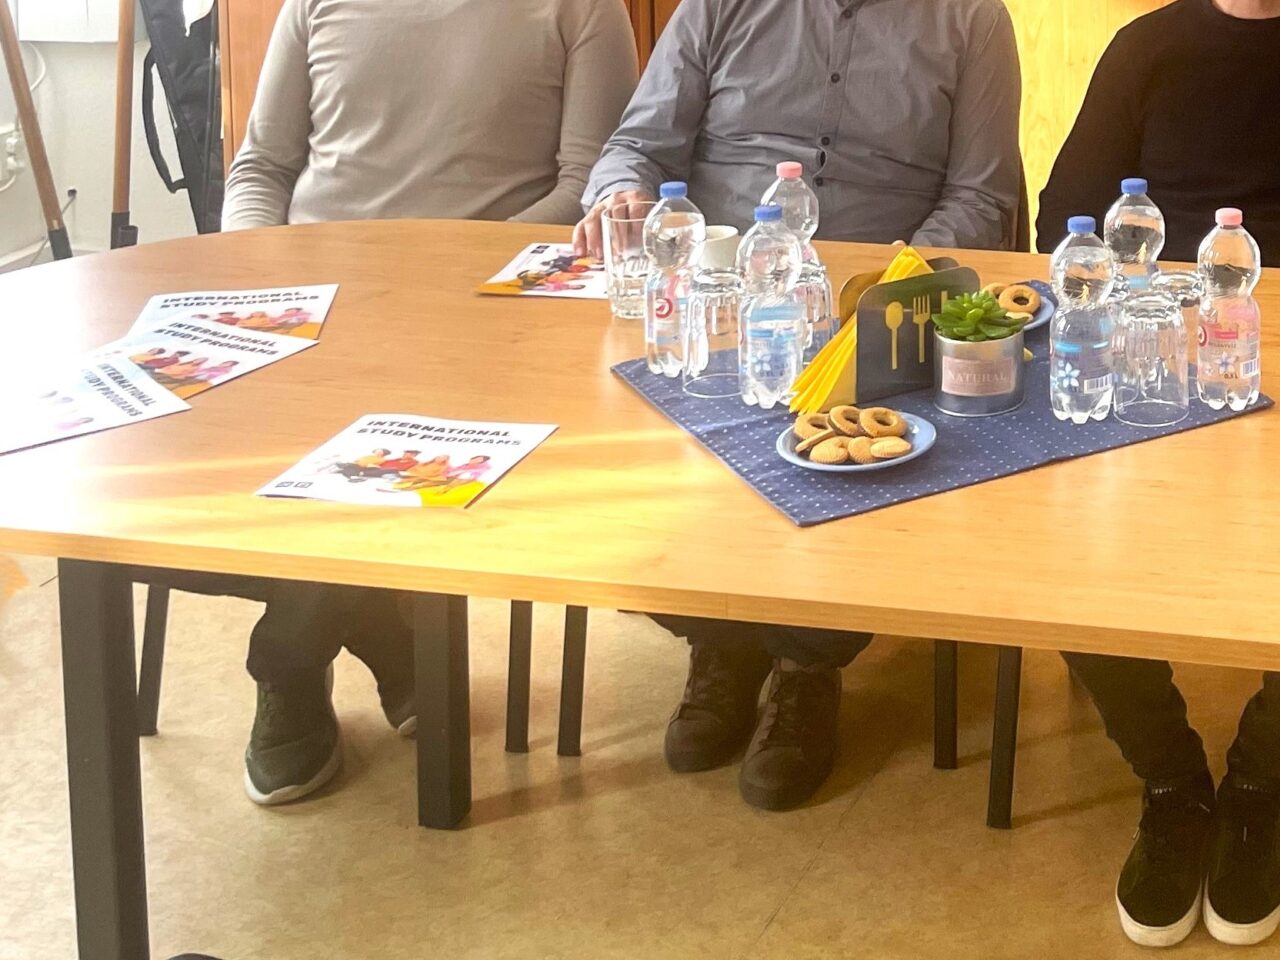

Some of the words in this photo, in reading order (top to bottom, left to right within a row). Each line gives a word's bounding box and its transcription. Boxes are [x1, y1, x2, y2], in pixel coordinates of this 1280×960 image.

[160, 301, 218, 309] STUDY
[221, 295, 319, 306] PROGRAMS
[163, 291, 303, 303] INTERNATIONAL
[153, 328, 201, 341] STUDY
[199, 338, 279, 355] PROGRAMS
[168, 322, 278, 347] INTERNATIONAL
[357, 428, 418, 438] STUDY
[419, 434, 522, 446] PROGRAMS
[367, 420, 511, 437] INTERNATIONAL
